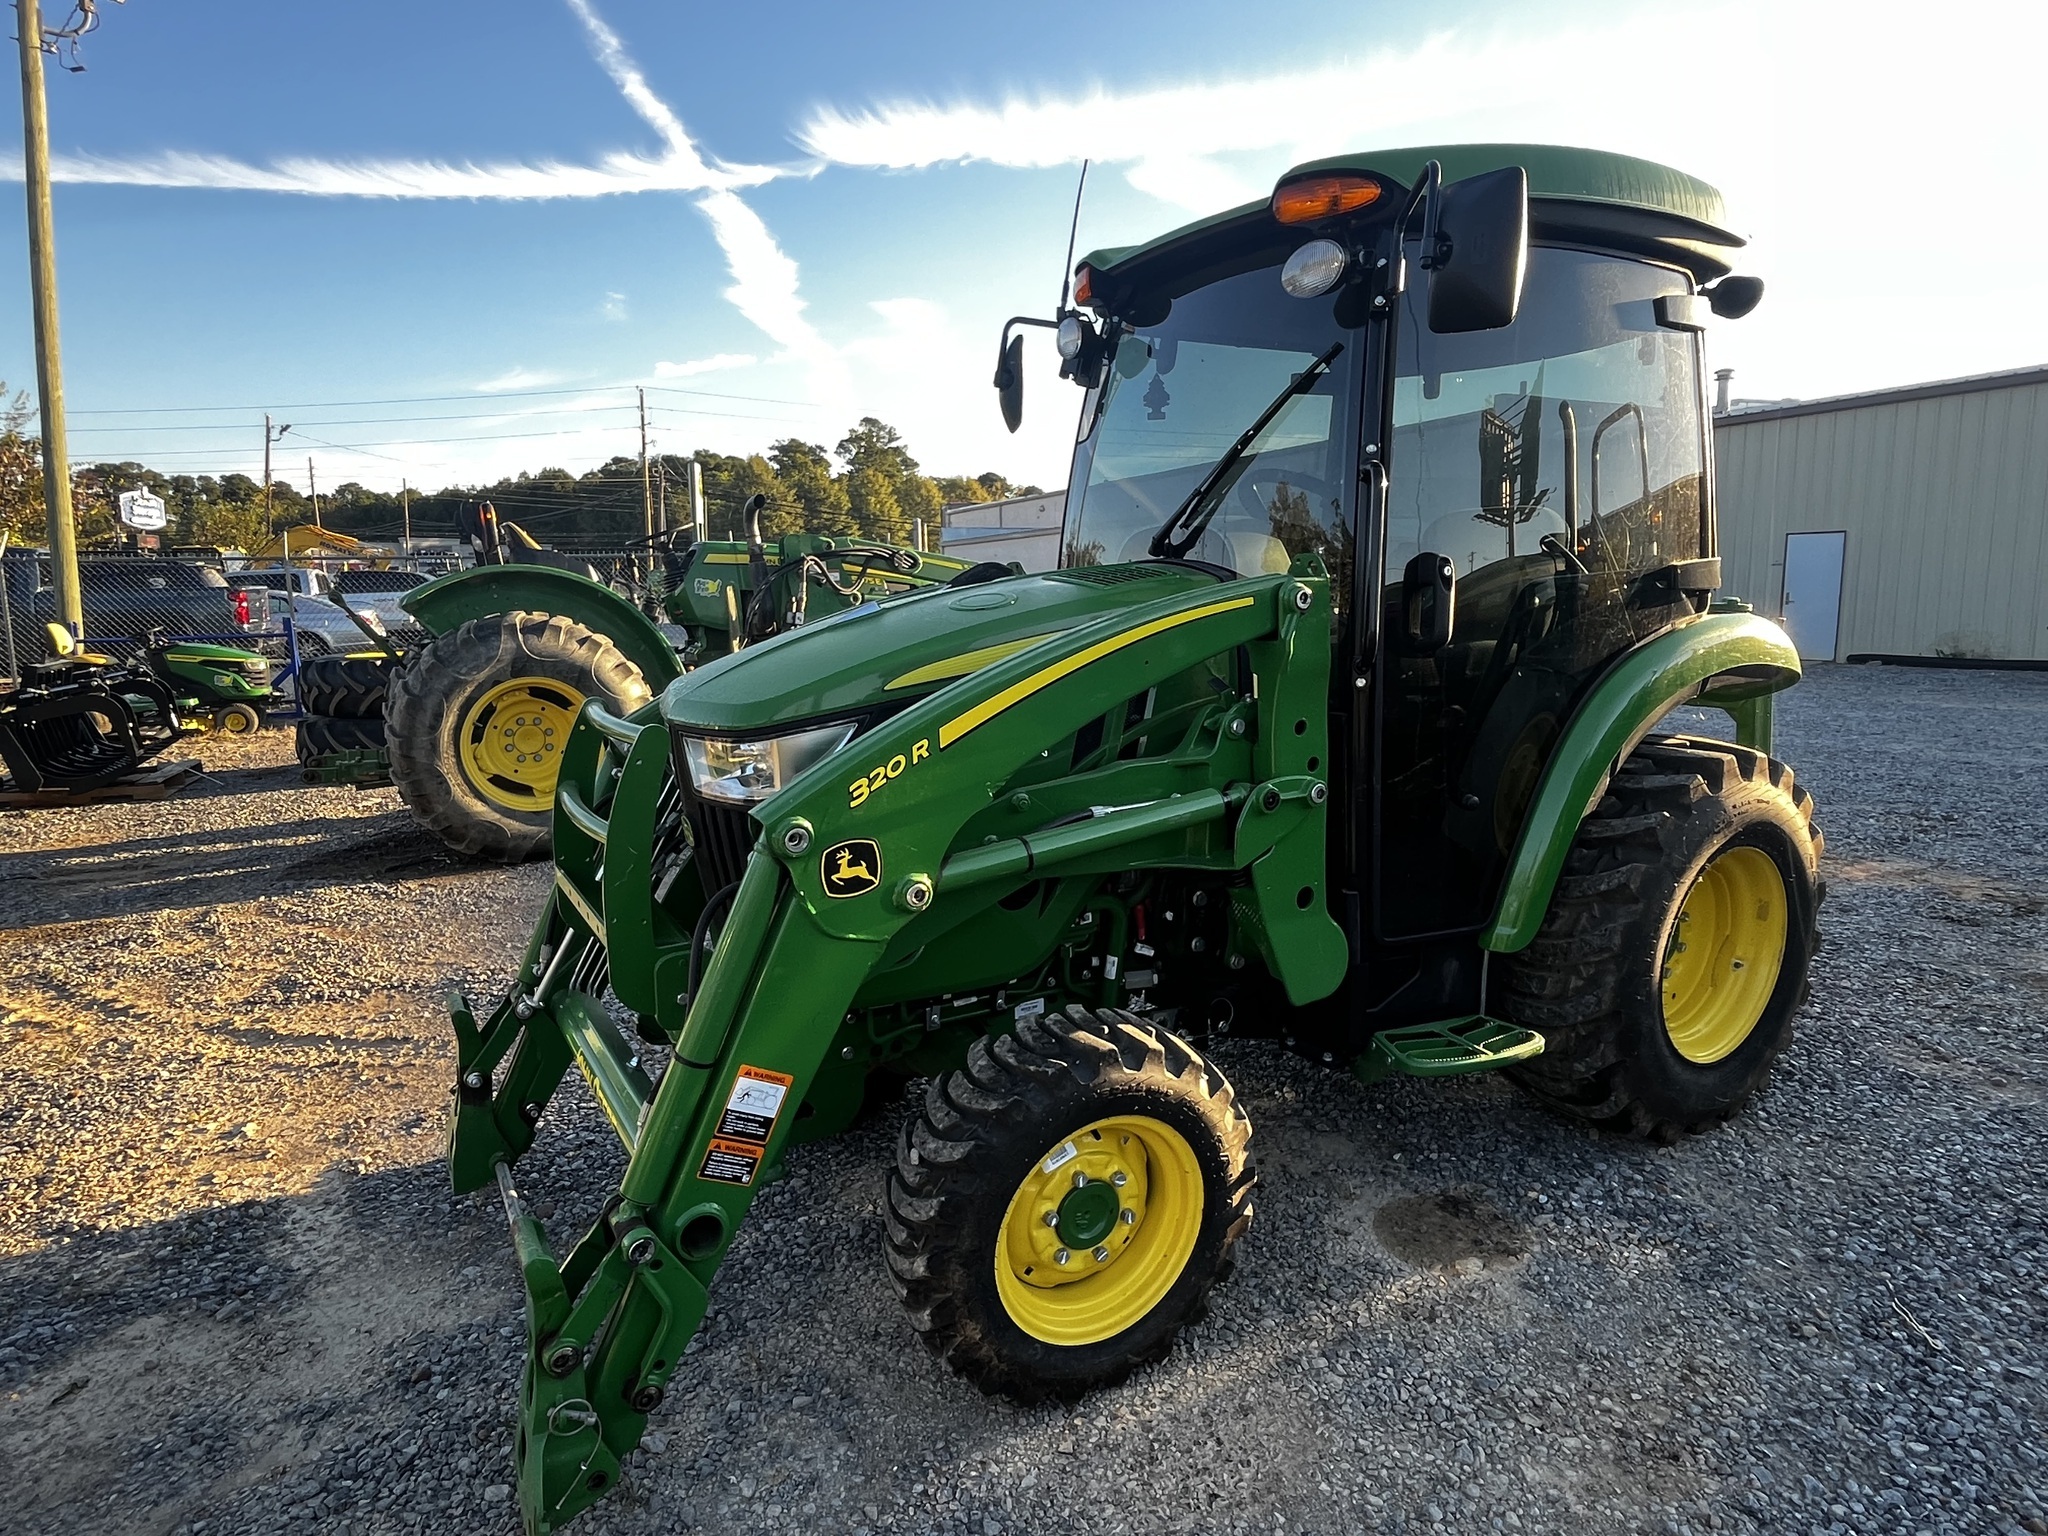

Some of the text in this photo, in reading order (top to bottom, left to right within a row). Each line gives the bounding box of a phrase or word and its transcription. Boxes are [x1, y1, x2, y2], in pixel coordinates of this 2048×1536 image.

[849, 738, 930, 808] 320 R
[753, 1071, 786, 1083] WARNING
[725, 1145, 758, 1156] WARNING
